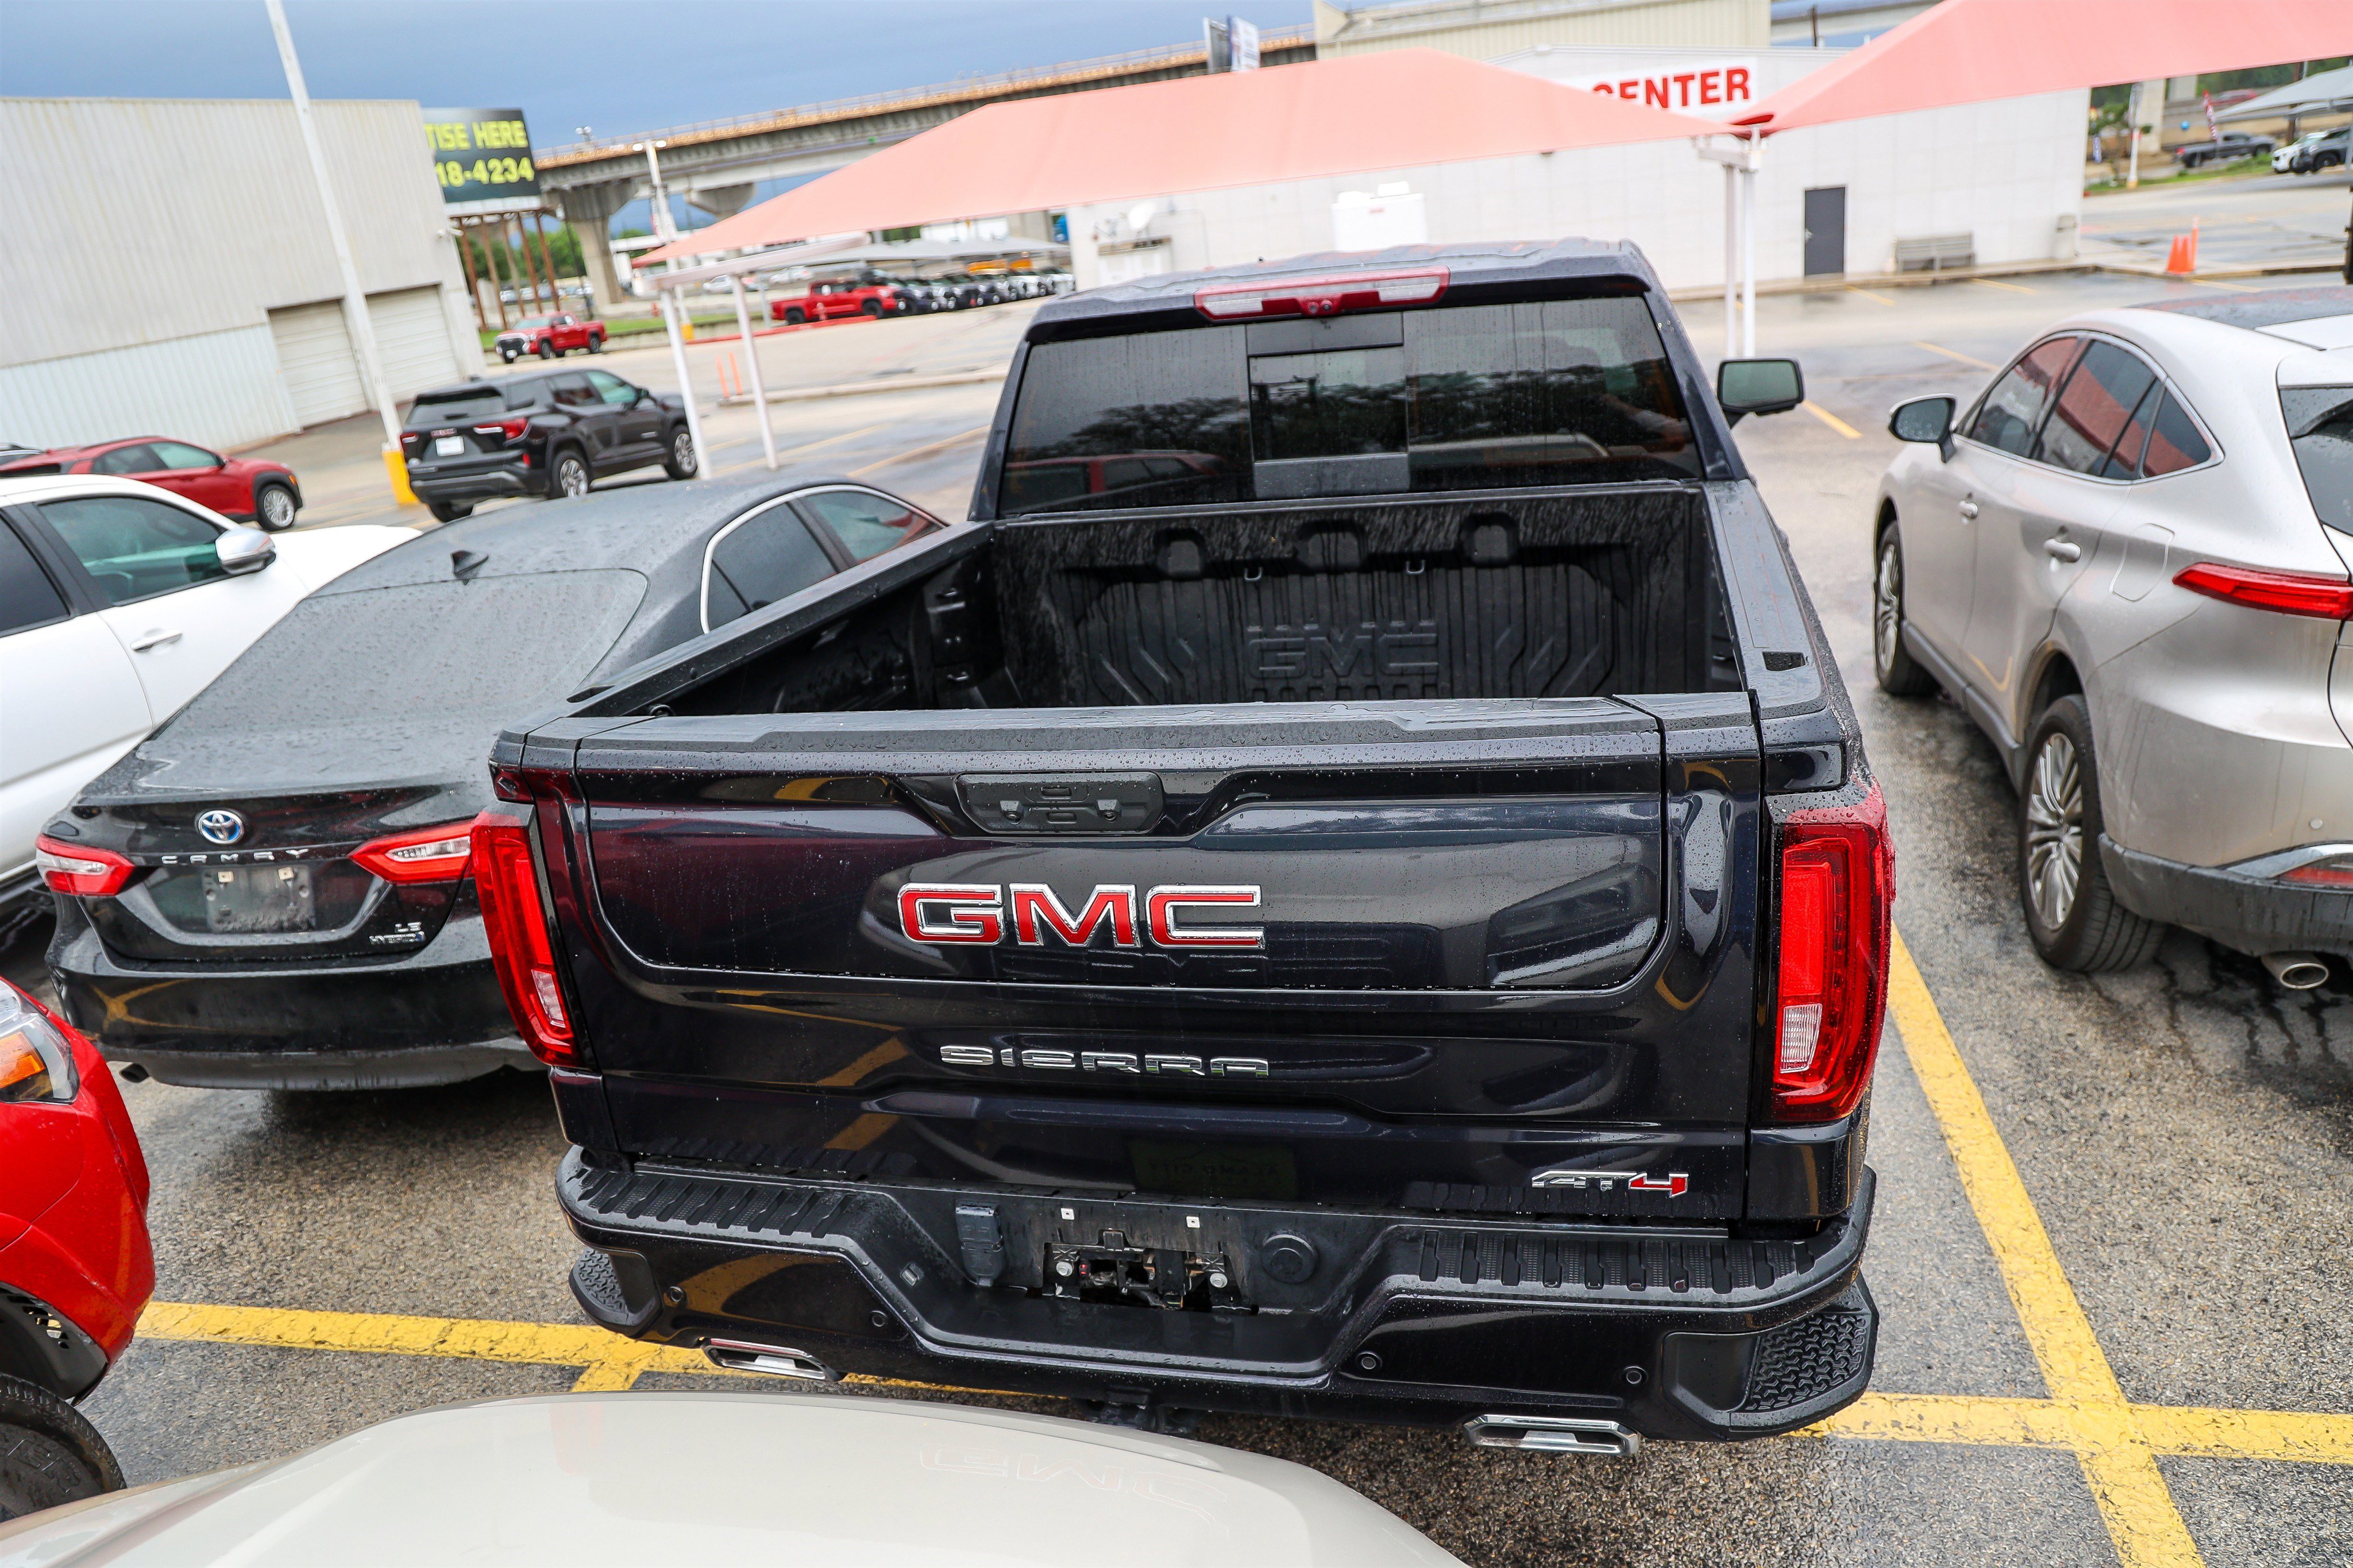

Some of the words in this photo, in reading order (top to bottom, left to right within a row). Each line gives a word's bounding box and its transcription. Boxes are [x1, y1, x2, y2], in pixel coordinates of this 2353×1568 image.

[1593, 68, 1749, 109] ENTER
[472, 120, 529, 149] HERE
[435, 157, 535, 187] 18-4234
[1248, 632, 1438, 679] GMC
[161, 848, 309, 864] CAMRY
[897, 882, 1265, 949] GMC
[940, 1045, 1270, 1077] SIERRA
[1532, 1169, 1689, 1198] AT4
